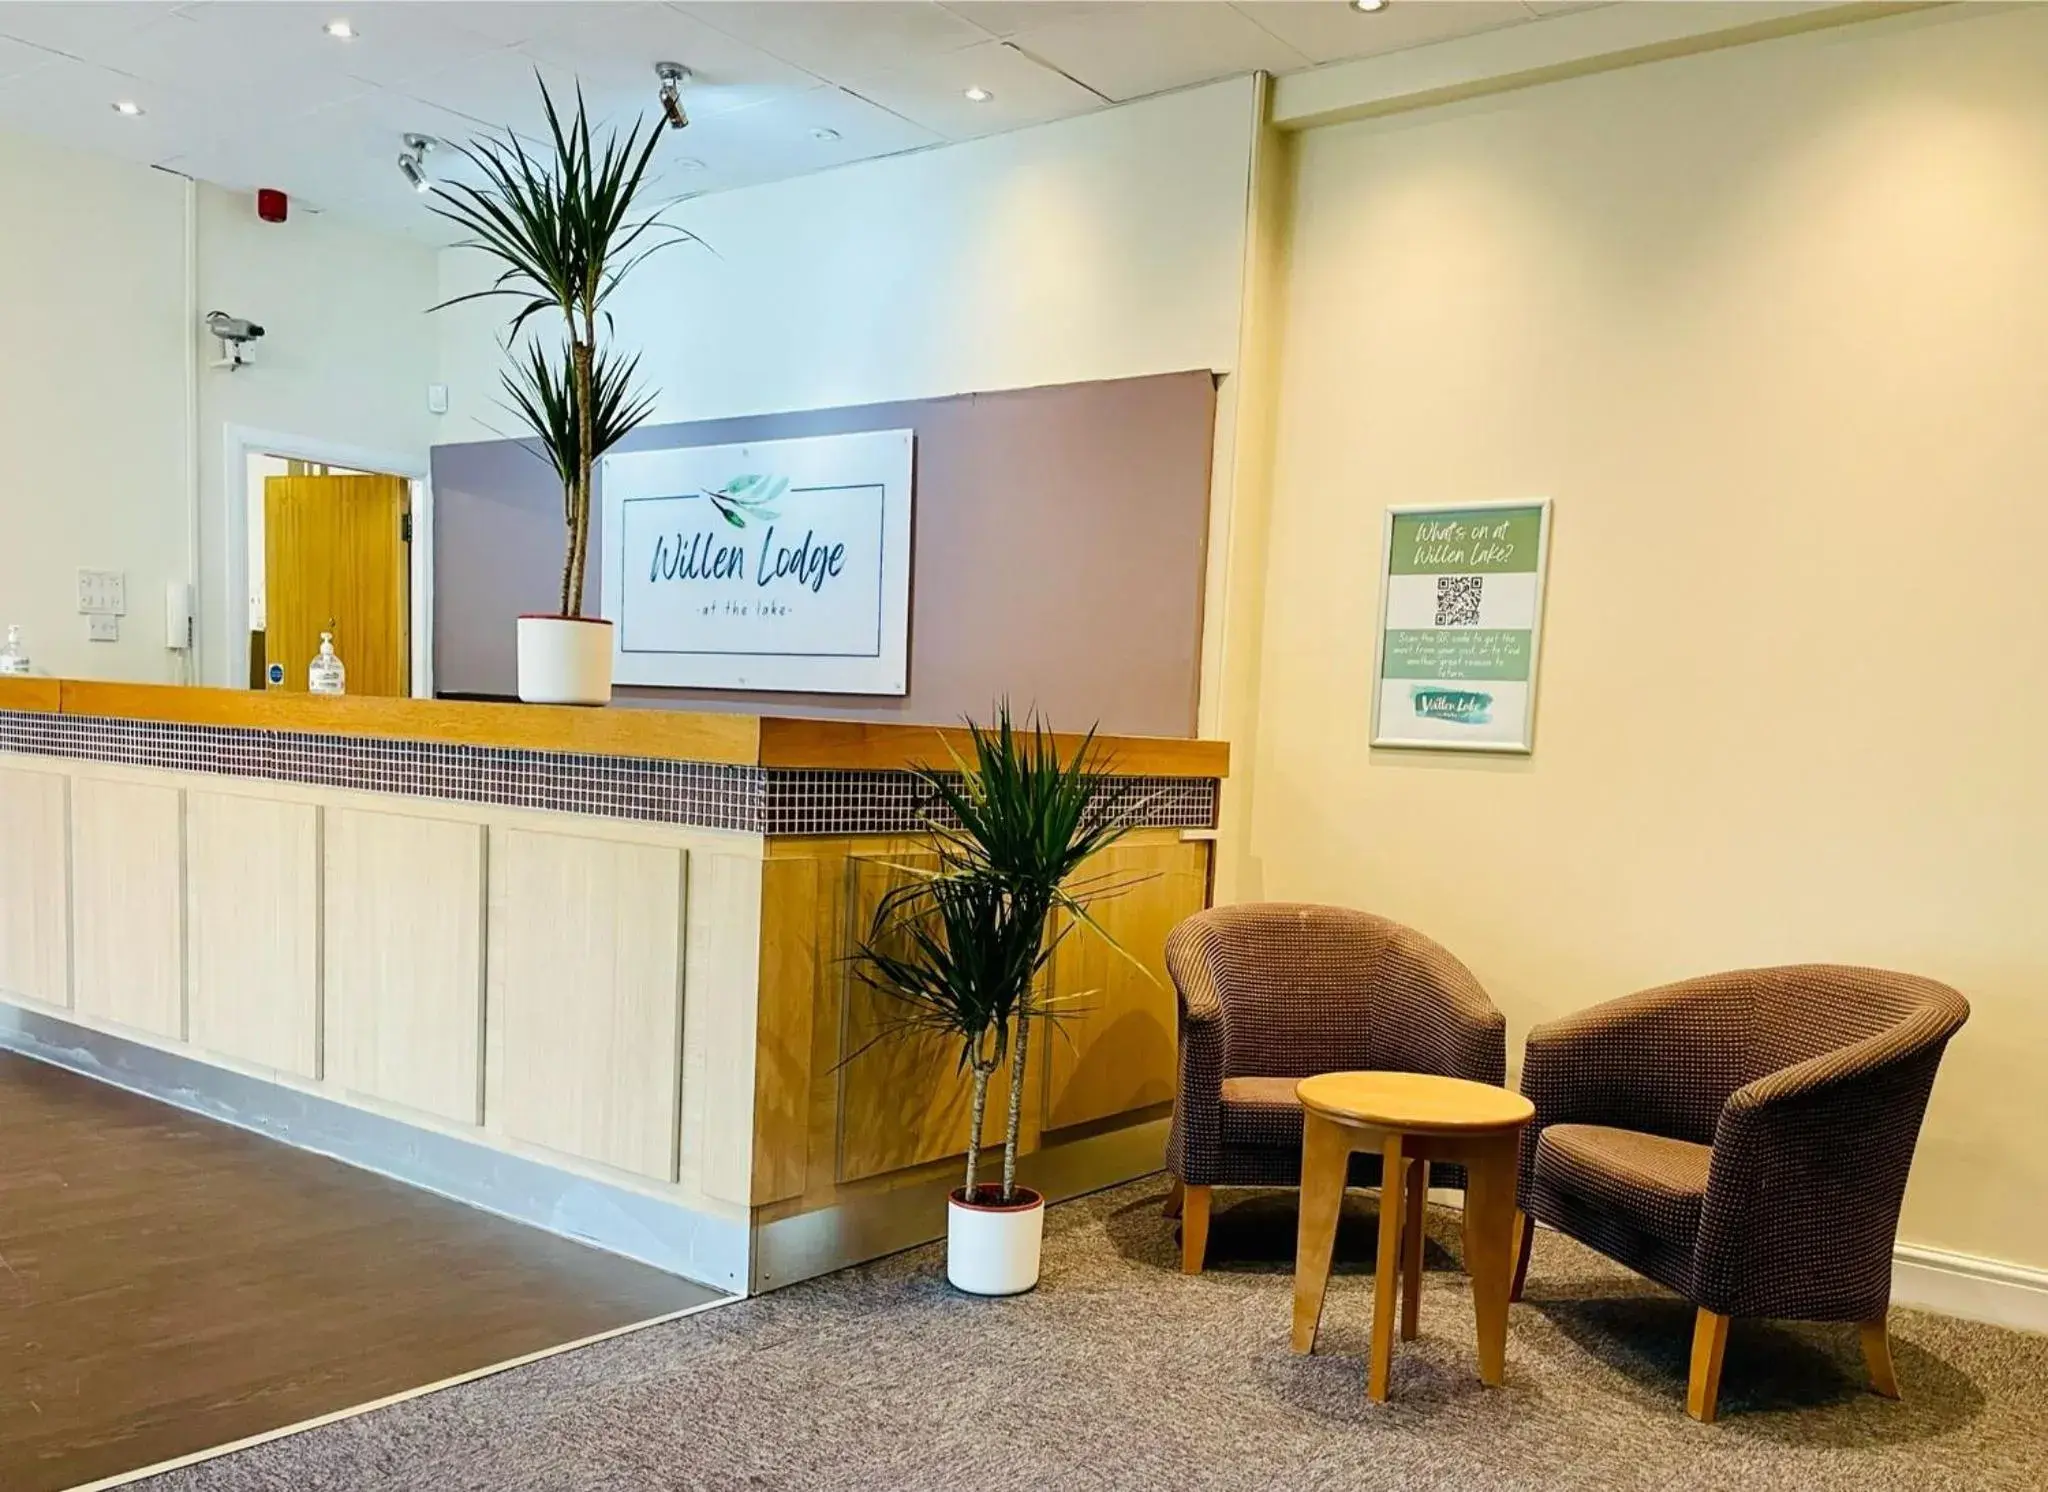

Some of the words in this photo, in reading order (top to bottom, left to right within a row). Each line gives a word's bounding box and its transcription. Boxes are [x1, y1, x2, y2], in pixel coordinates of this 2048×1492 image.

[1415, 521, 1467, 542] What's
[1471, 525, 1488, 539] on
[1492, 520, 1509, 540] at
[650, 532, 744, 583] Willen
[757, 525, 845, 593] Lodge
[1414, 544, 1464, 565] Willen
[1470, 543, 1514, 566] Lake?
[725, 600, 747, 616] the
[1422, 633, 1435, 643] the
[1473, 632, 1482, 643] to
[1502, 632, 1516, 643] the
